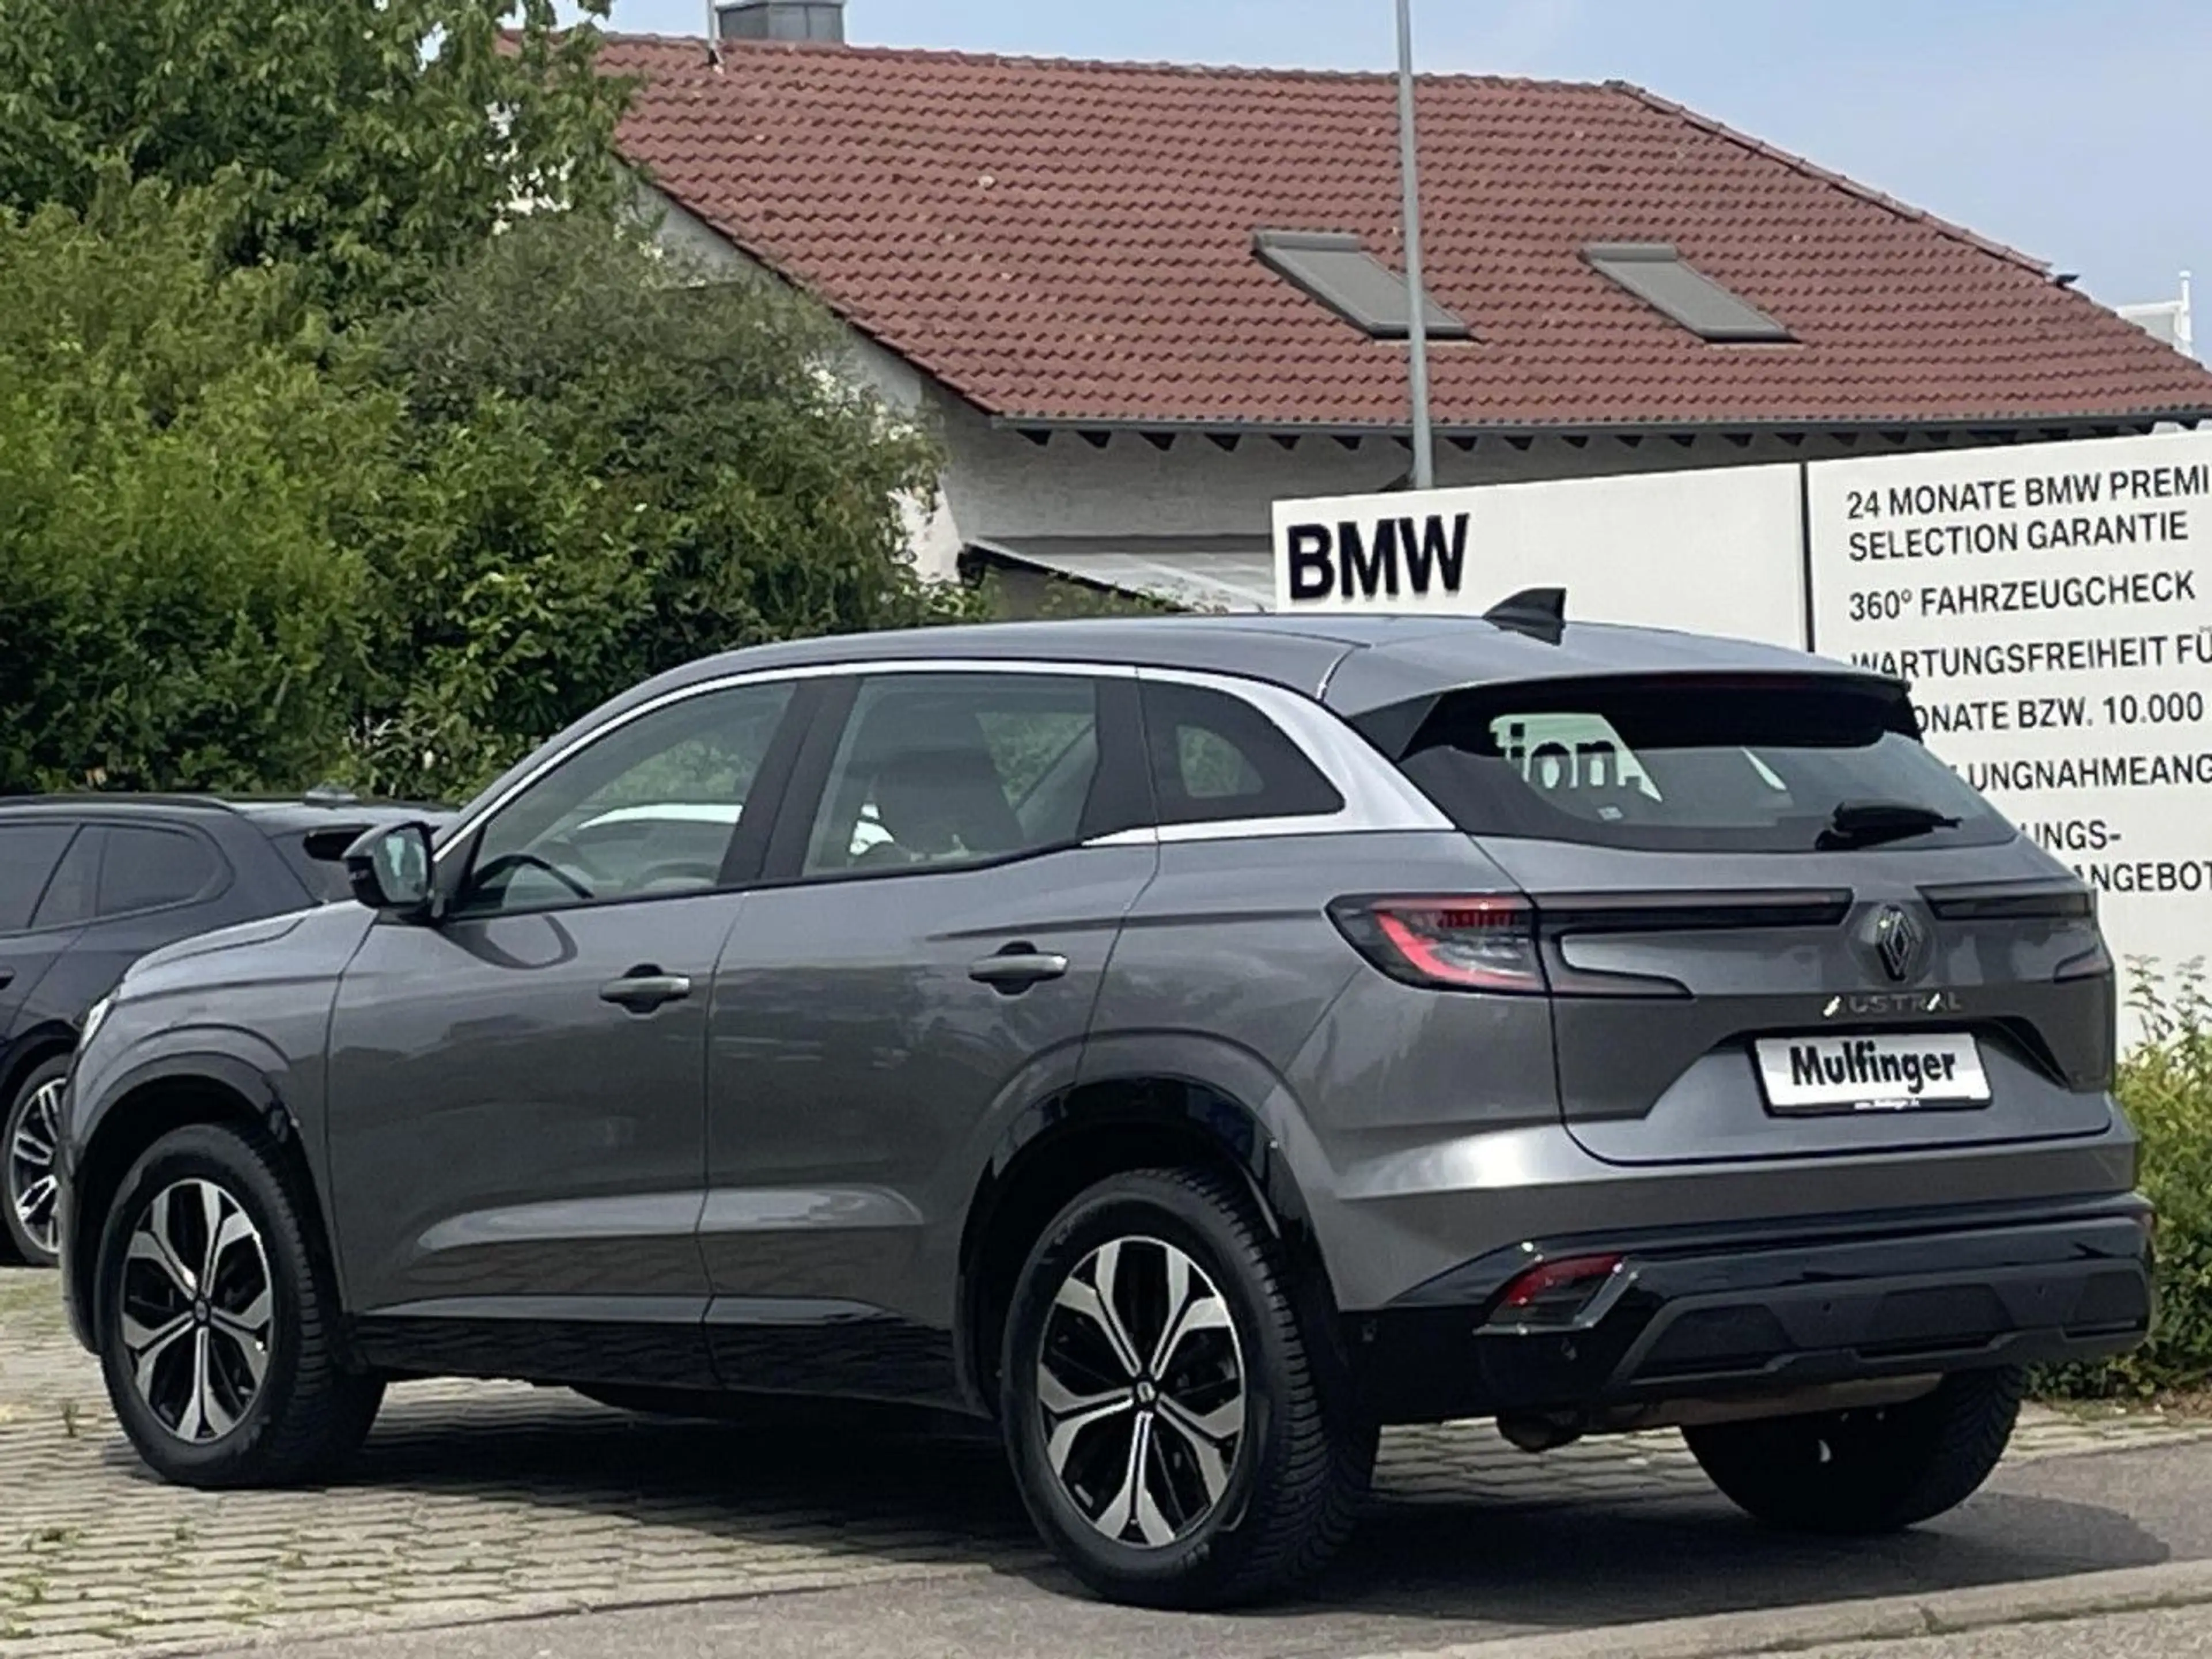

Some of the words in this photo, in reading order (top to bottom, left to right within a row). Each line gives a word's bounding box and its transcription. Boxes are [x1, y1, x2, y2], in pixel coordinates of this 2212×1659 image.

[1847, 491, 1880, 520] 24
[1889, 479, 2016, 517] MONATE
[2025, 473, 2101, 507] BMW
[2109, 464, 2209, 500] PREMI
[1287, 512, 1470, 601] BMW
[1849, 522, 2018, 562] SELECTION
[2027, 510, 2189, 551] GARANTIE
[1921, 570, 2196, 616] FAHRZEUGCHECK
[2018, 696, 2093, 729] BZW.
[2103, 691, 2204, 725] 10.000
[1789, 1040, 1956, 1094] Mulfinger
